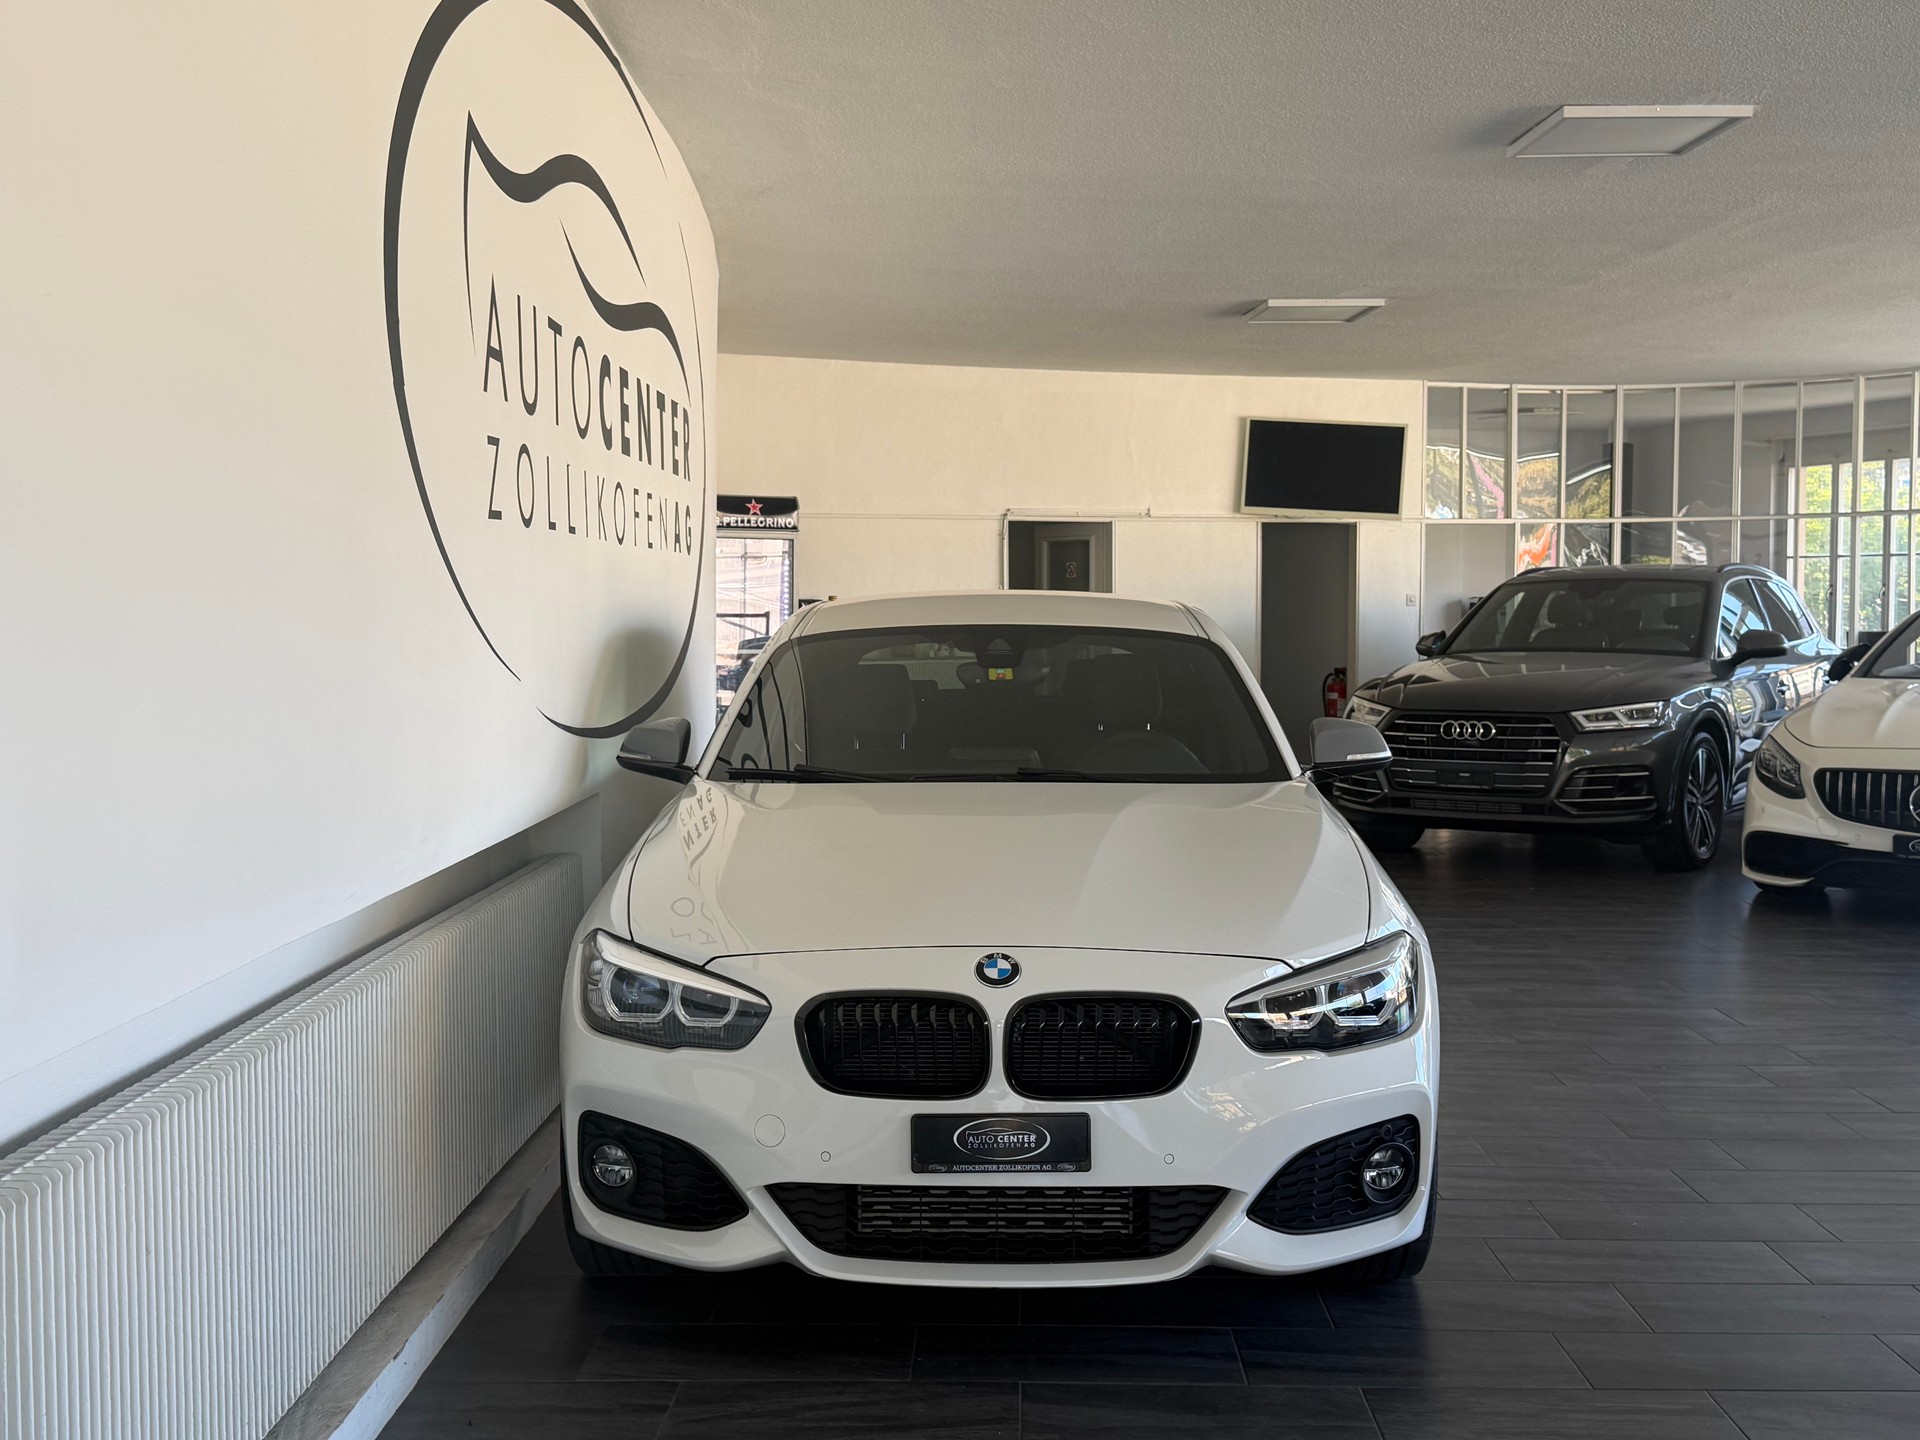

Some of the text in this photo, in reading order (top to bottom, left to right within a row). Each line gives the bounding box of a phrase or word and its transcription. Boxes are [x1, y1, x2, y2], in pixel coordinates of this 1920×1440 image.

[980, 953, 1016, 964] BMW
[968, 1135, 1036, 1143] AUTO CENTER
